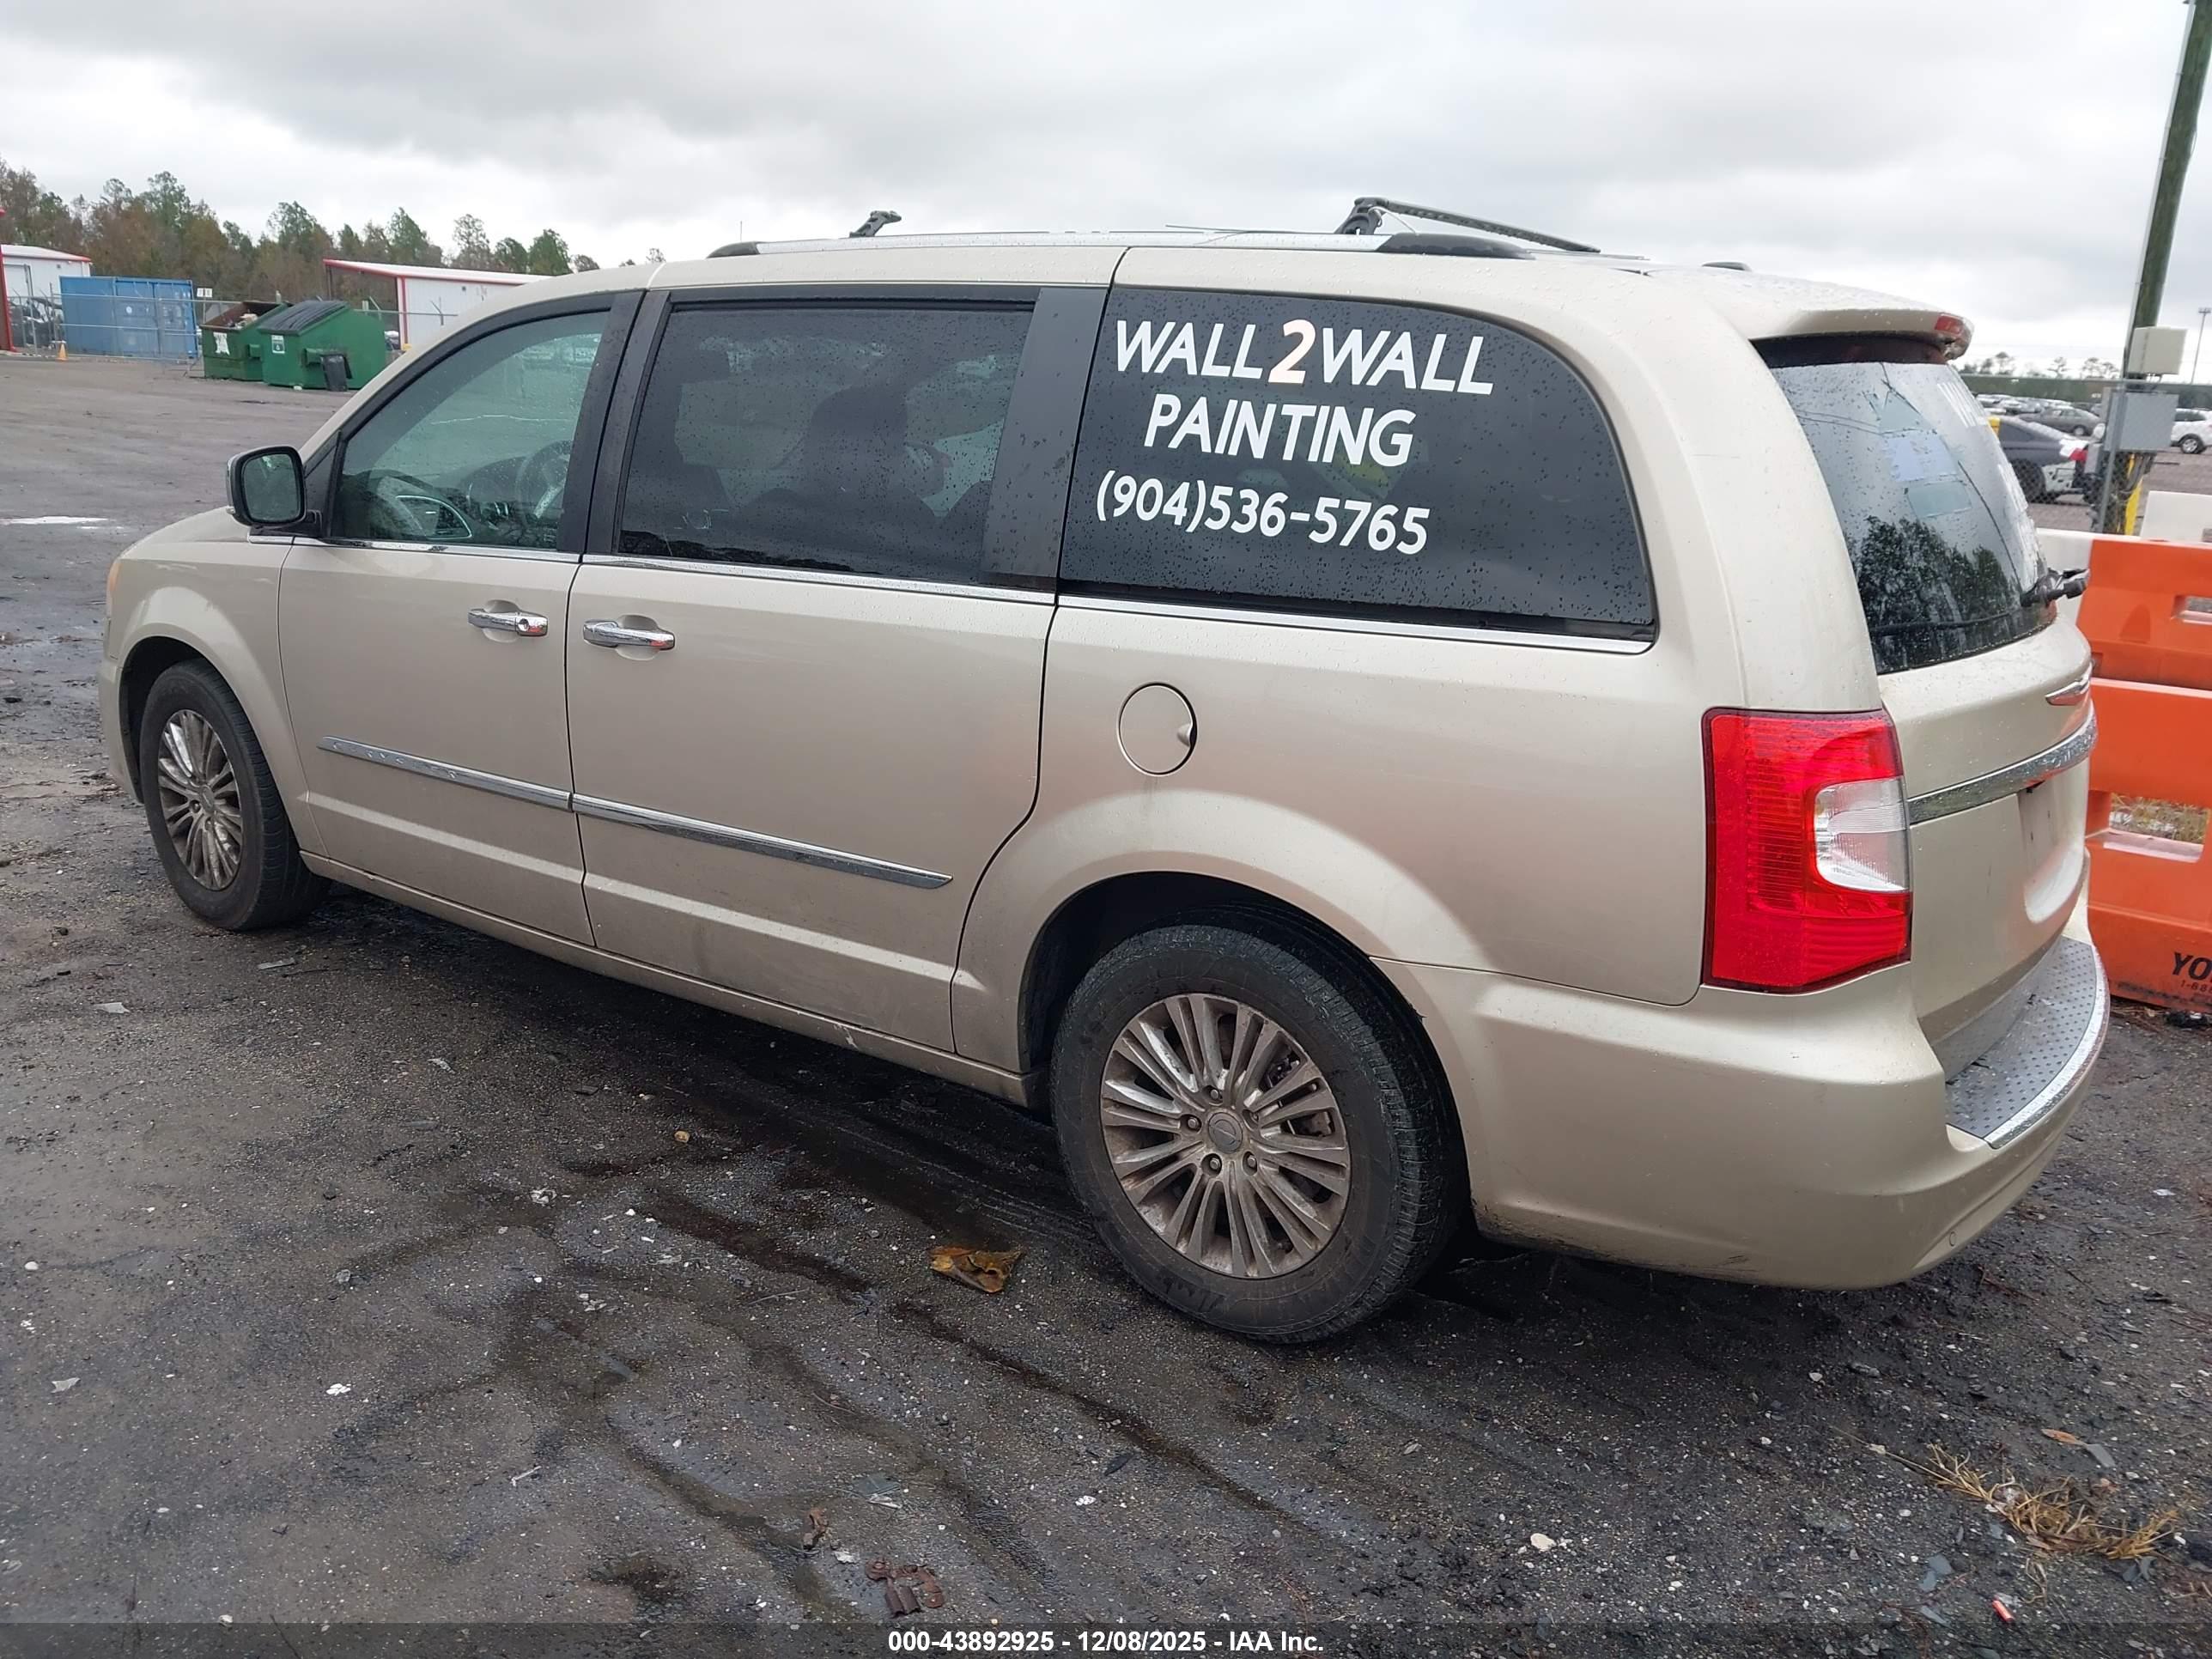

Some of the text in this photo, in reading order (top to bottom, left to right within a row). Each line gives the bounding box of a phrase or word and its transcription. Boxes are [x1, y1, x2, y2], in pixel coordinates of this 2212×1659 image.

[1116, 319, 1494, 395] WALL2WALL
[1144, 393, 1417, 467] PAINTING
[1097, 470, 1431, 555] (904)536-5765
[2172, 951, 2212, 981] YO
